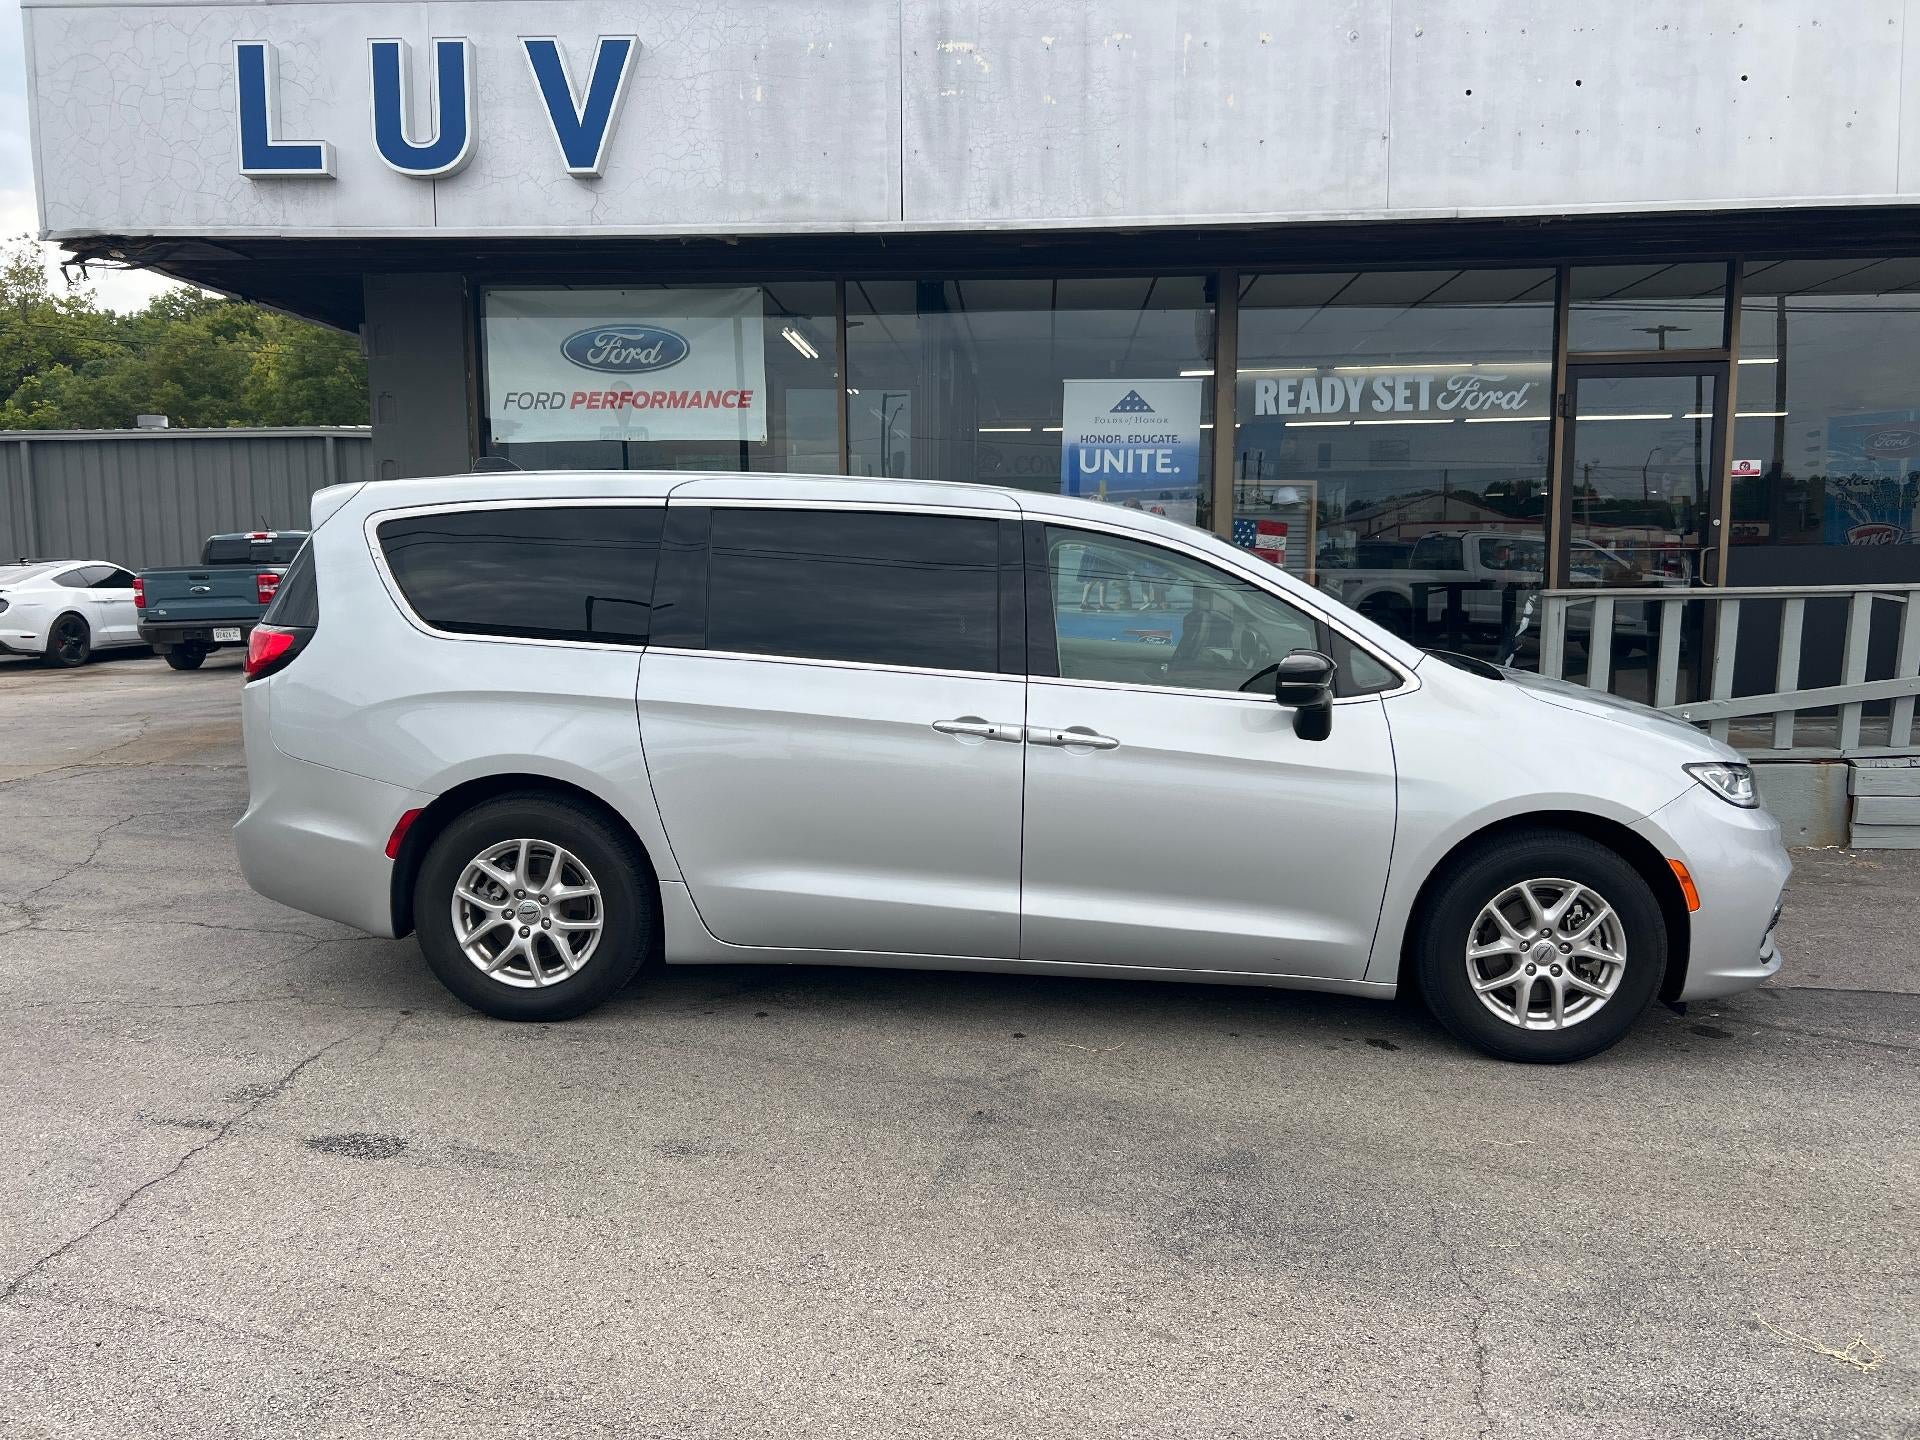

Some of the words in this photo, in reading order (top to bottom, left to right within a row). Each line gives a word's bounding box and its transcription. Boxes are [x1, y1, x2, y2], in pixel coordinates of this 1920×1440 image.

[232, 35, 640, 178] LUV
[586, 331, 663, 365] Ford
[503, 391, 566, 411] FORD
[569, 389, 754, 410] PERFORMANCE
[1254, 375, 1366, 416] READY
[1371, 374, 1435, 412] SET
[1436, 373, 1532, 411] Ford
[1080, 434, 1124, 444] HONOR.
[1127, 434, 1181, 444] EDUCATE.
[1873, 432, 1912, 448] Ford
[1079, 448, 1181, 474] UNITE.
